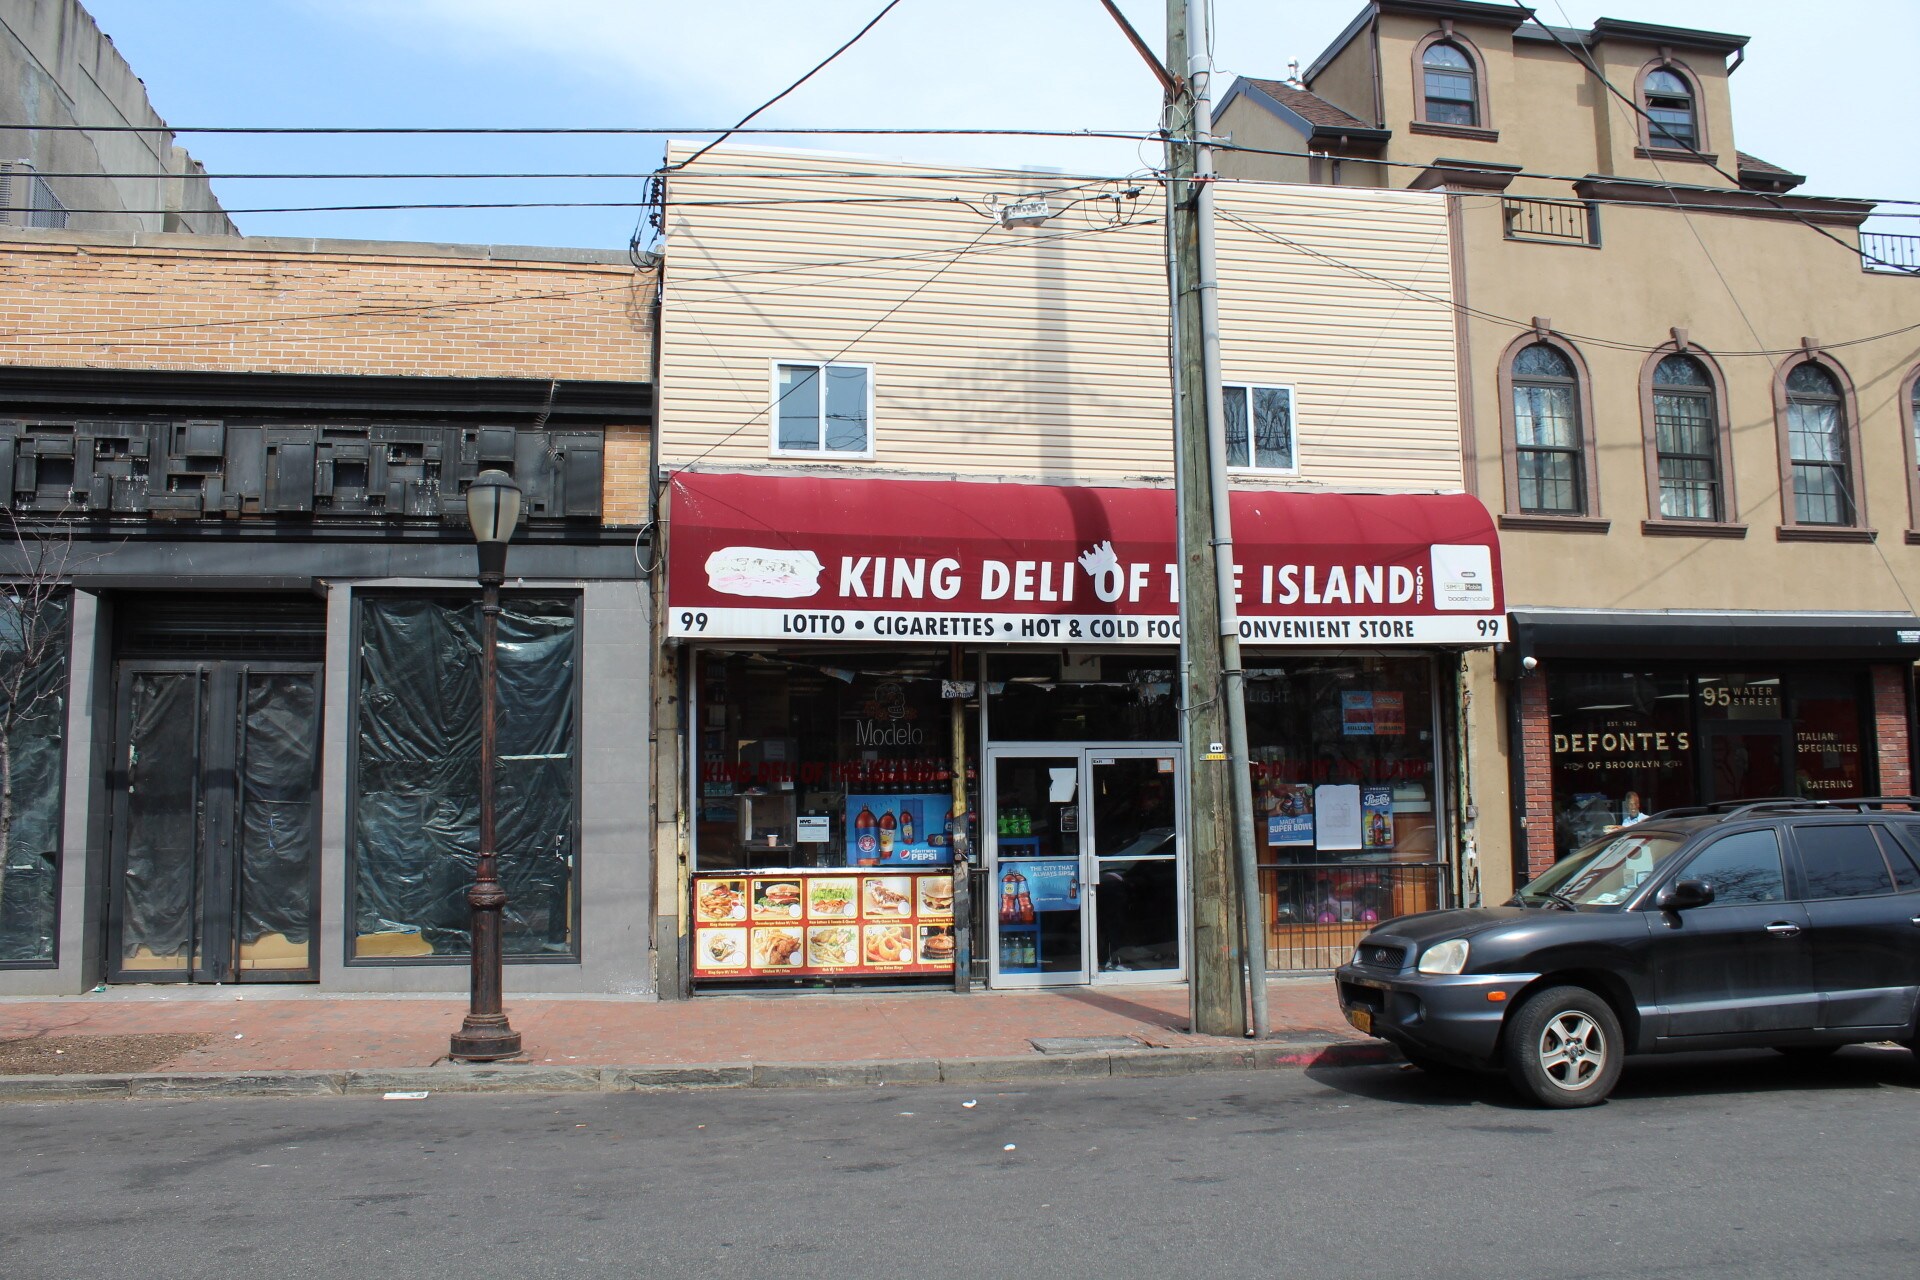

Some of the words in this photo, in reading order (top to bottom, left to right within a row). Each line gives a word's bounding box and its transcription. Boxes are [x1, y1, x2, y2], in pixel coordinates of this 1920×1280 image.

[839, 556, 961, 600] KING
[980, 560, 1075, 602] DELI
[1094, 561, 1149, 604] OF
[1262, 565, 1415, 604] ISLAND
[1416, 566, 1424, 604] CORP
[680, 612, 708, 632] 99
[783, 614, 845, 634] LOTTO
[873, 616, 995, 637] CIGARETTES
[1021, 619, 1060, 638] HOT
[1069, 619, 1083, 638] &
[1090, 620, 1139, 639] COLD
[1147, 620, 1180, 639] FOO
[1238, 621, 1350, 640] ONVENIENT
[1360, 621, 1415, 639] STORE
[1476, 620, 1499, 638] 99
[1249, 690, 1289, 703] LIGHT
[1703, 687, 1731, 706] 95
[1733, 687, 1772, 695] WATER
[1733, 697, 1778, 706] STREET
[855, 719, 923, 746] Modelo
[1797, 732, 1834, 741] ITALIAN
[1554, 732, 1689, 753] DEFONTE'S
[1797, 744, 1858, 753] SPECIALTIES
[703, 761, 751, 783] KING
[757, 761, 796, 783] DELI
[802, 761, 825, 783] OF
[1587, 761, 1601, 769] OF
[1605, 760, 1660, 769] BROOKLYN
[1806, 780, 1853, 789] CATERING
[1269, 824, 1292, 833] SUPER
[1293, 822, 1313, 831] BOWL
[911, 853, 937, 861] PEPSI
